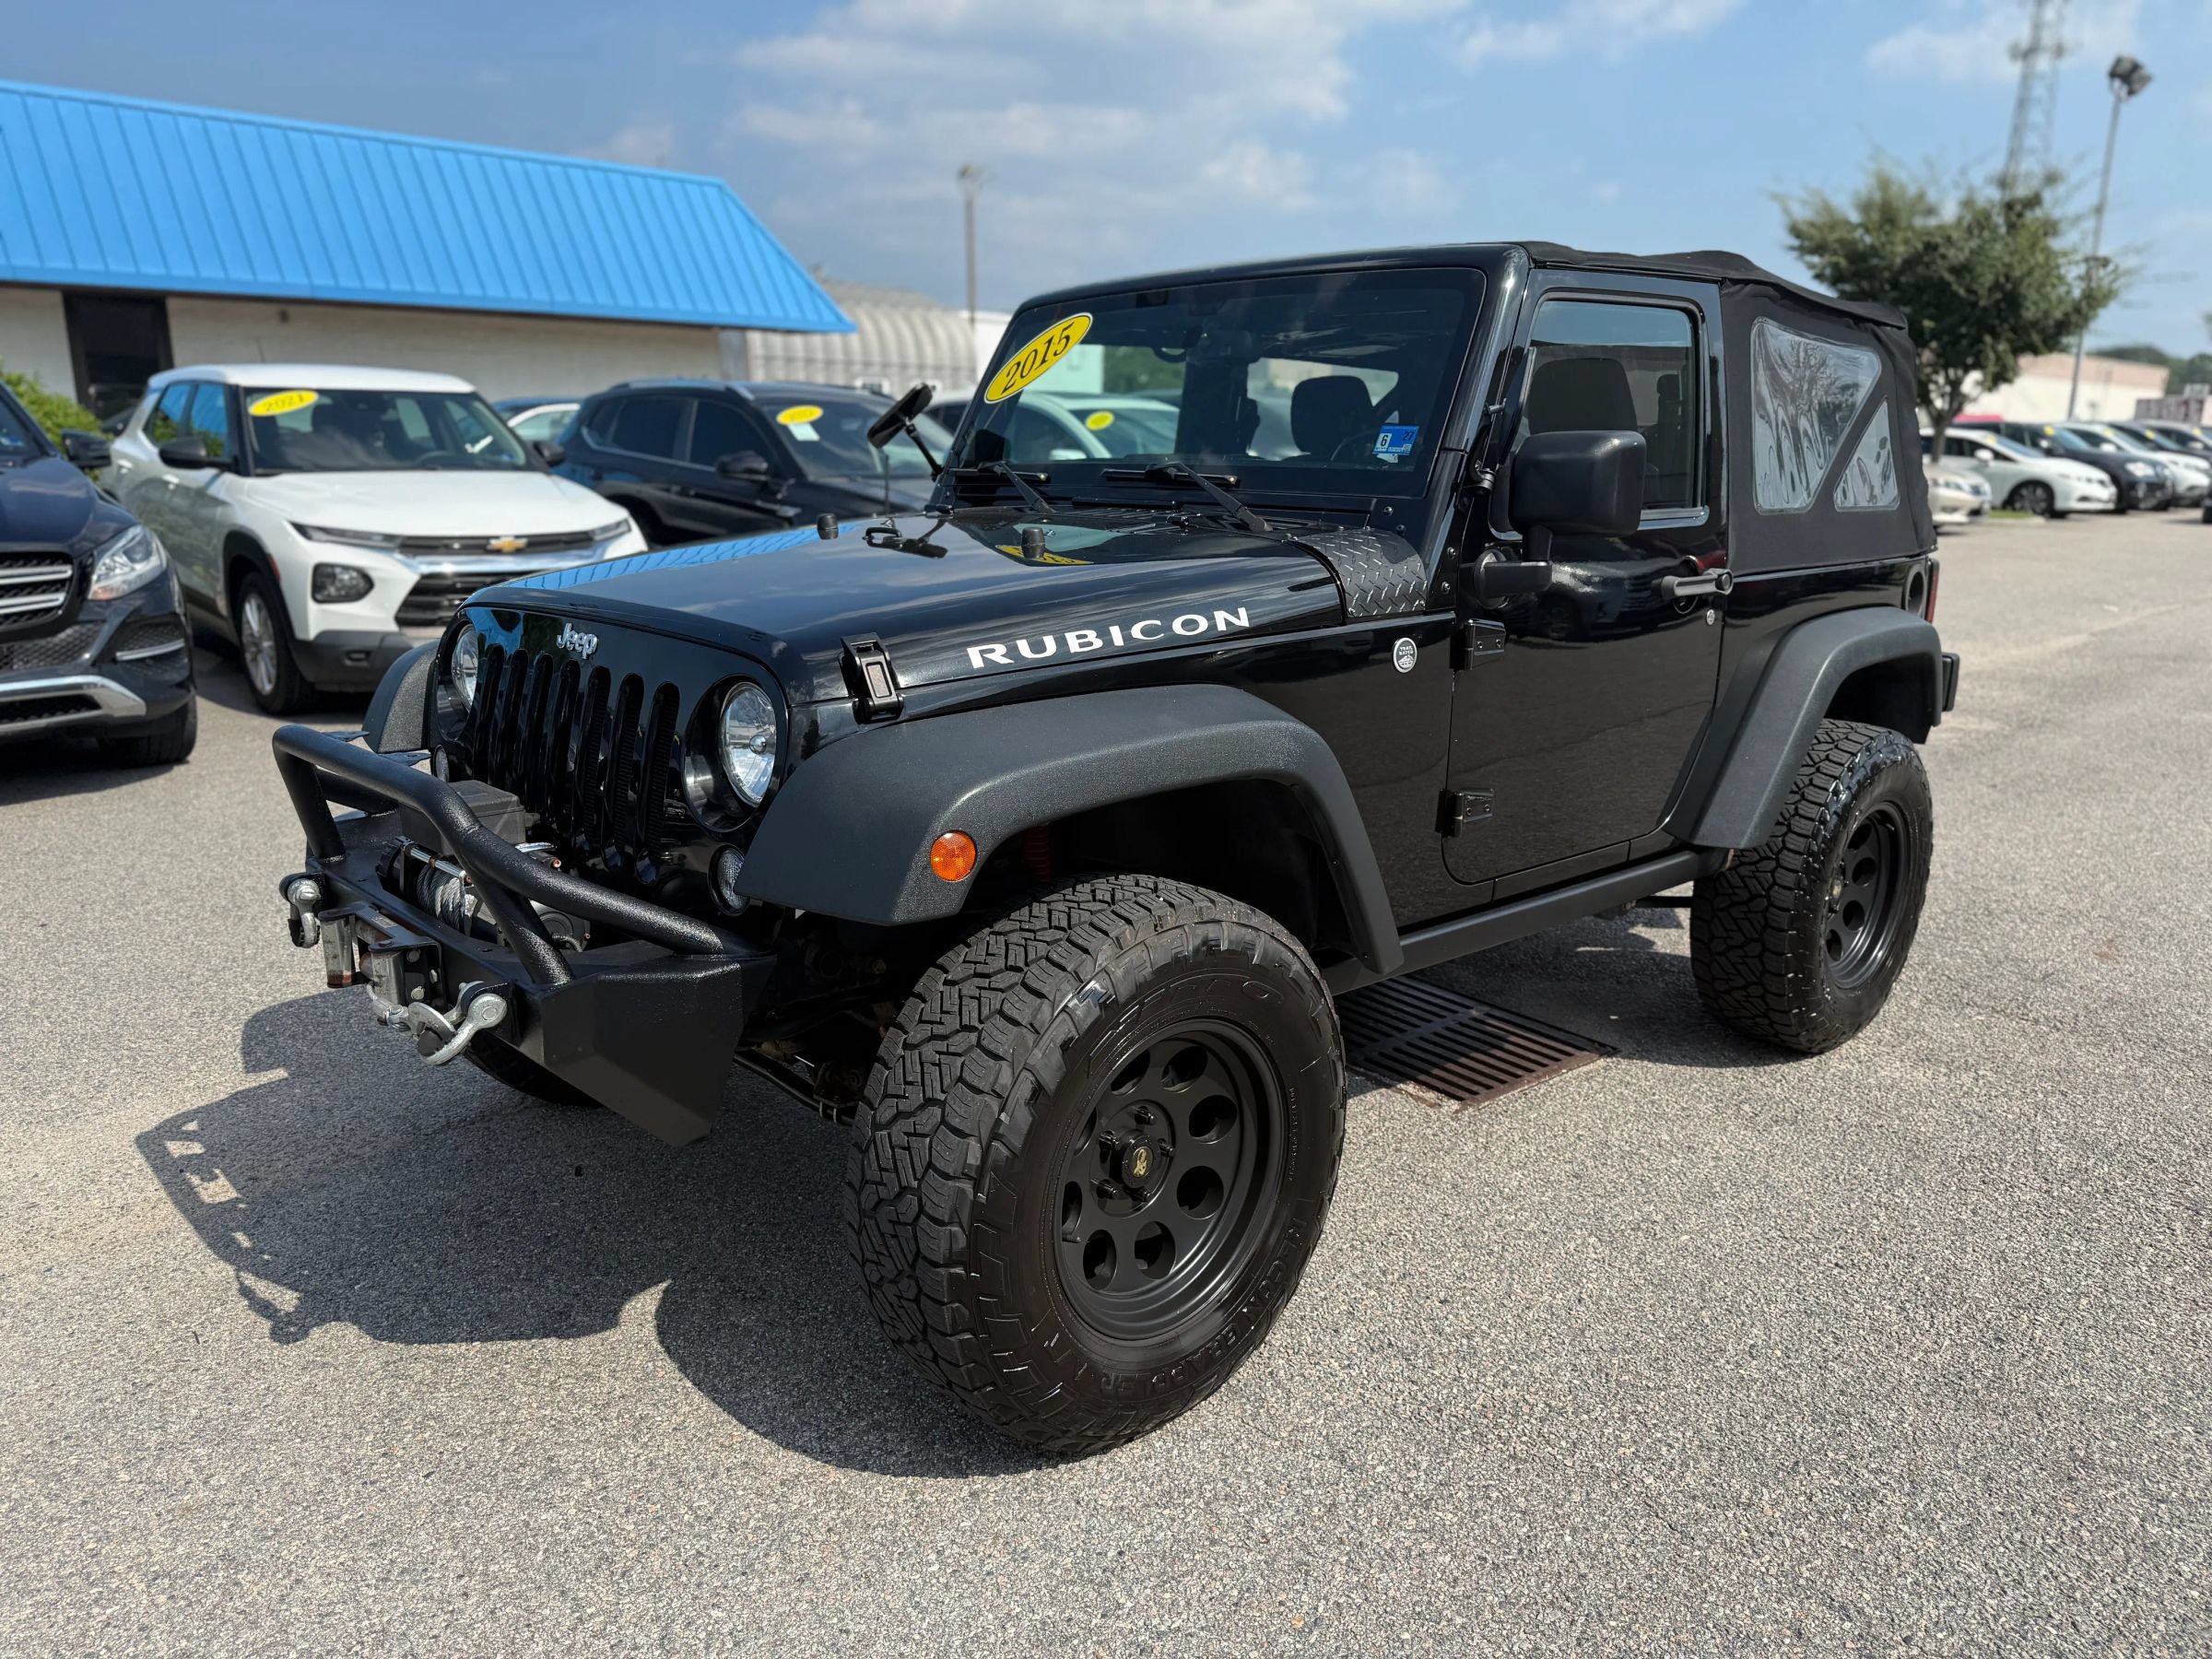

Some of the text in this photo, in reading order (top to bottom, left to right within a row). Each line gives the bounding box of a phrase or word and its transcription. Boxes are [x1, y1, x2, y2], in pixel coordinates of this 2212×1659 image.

[1001, 322, 1075, 394] 2015
[265, 393, 304, 412] 2021
[1381, 435, 1388, 446] 6
[1402, 431, 1414, 441] 27
[557, 623, 598, 660] Jeep
[967, 607, 1250, 669] RUBICON
